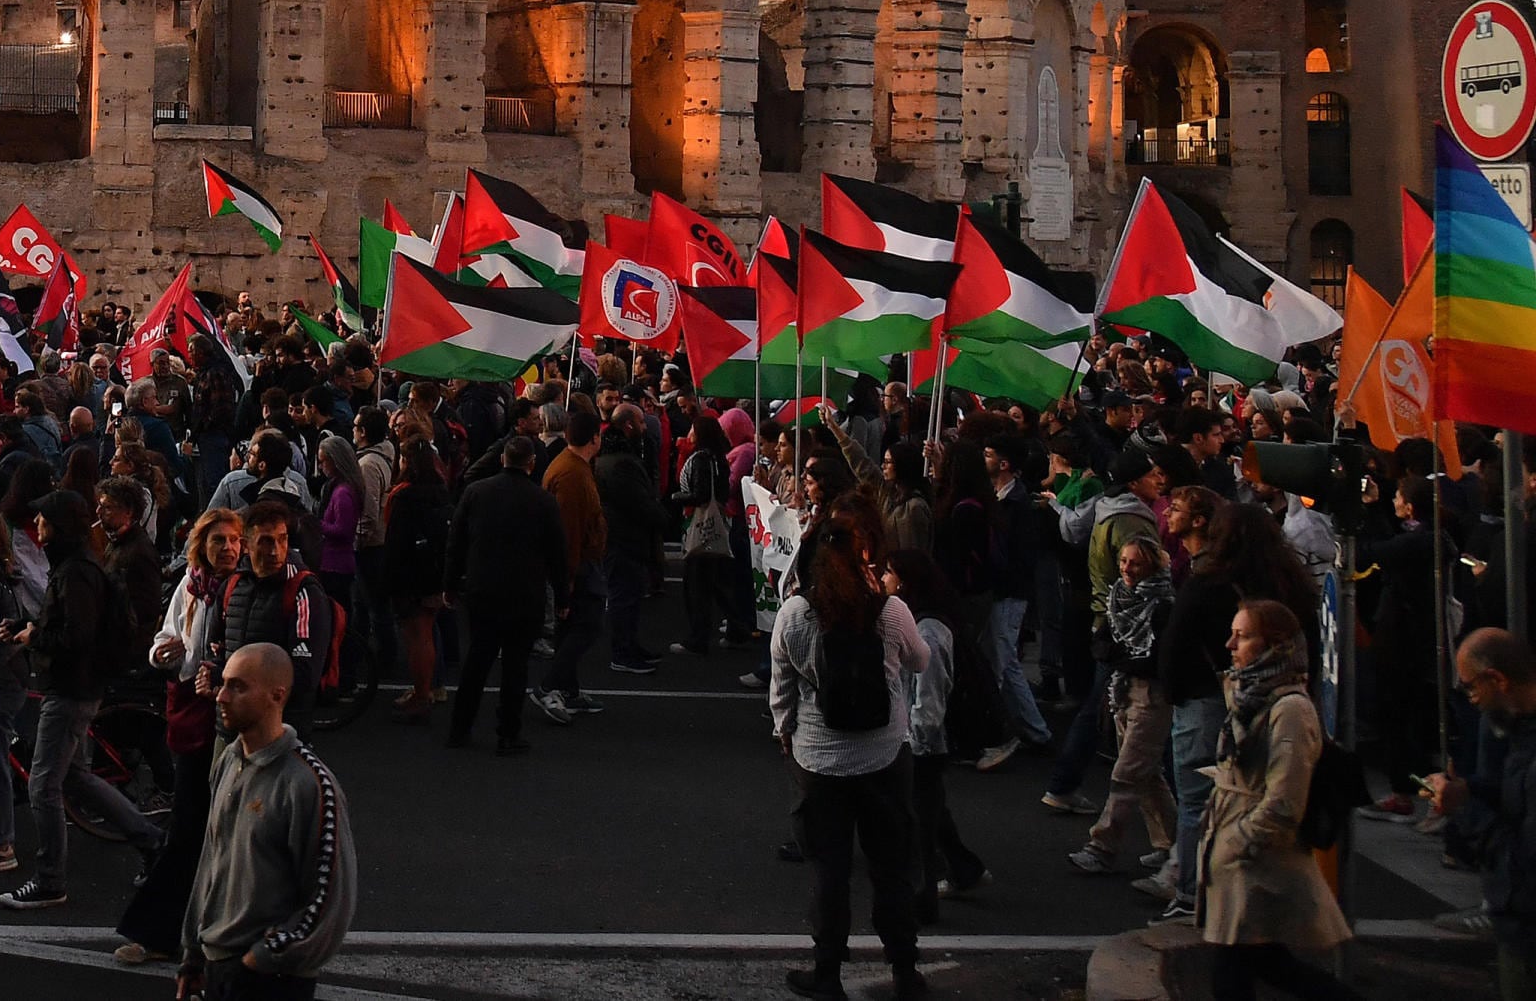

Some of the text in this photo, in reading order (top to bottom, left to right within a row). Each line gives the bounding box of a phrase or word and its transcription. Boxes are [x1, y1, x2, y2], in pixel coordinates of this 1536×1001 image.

[1492, 176, 1522, 195] etto
[12, 227, 66, 278] CG
[690, 222, 738, 279] CGIL
